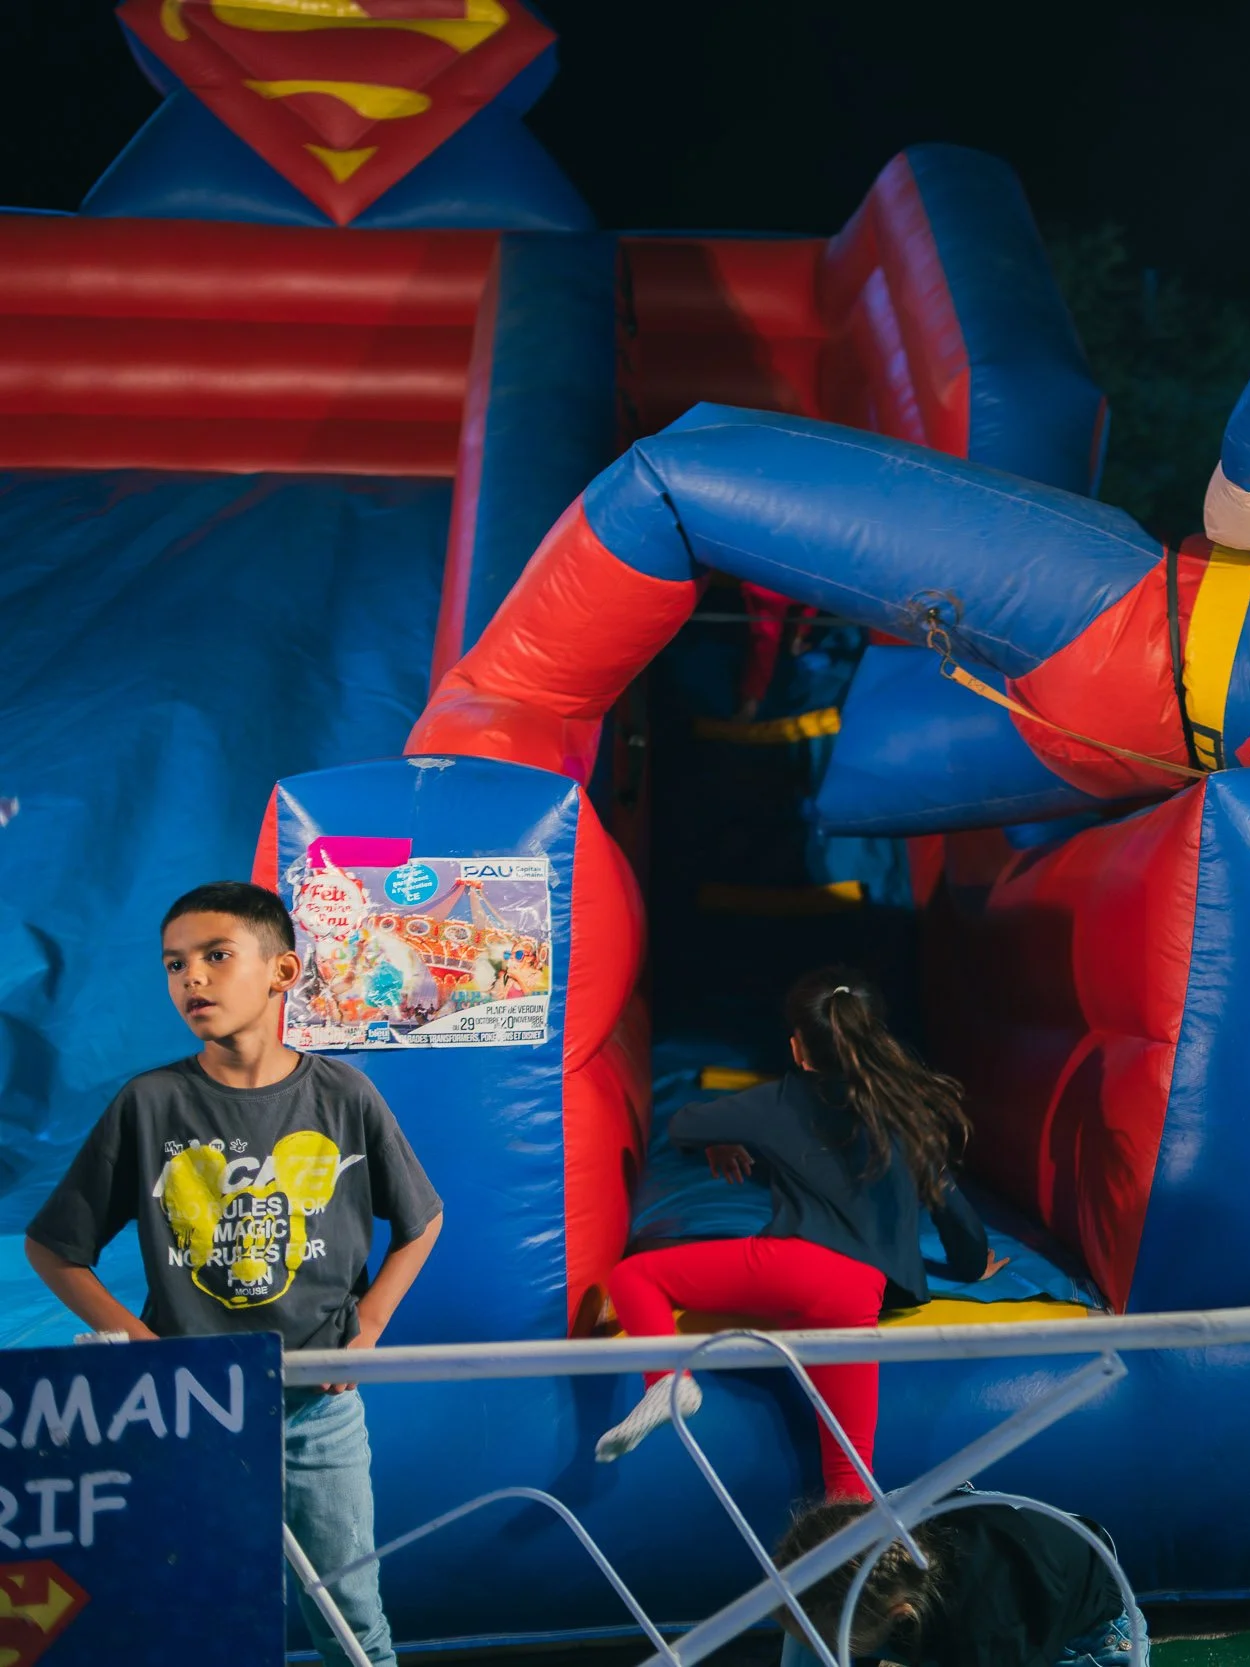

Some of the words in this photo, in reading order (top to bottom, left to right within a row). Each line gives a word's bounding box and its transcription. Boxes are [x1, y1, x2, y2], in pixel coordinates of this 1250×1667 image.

[464, 865, 513, 878] PAU
[406, 892, 421, 902] CE
[517, 1004, 544, 1014] VERDUN
[460, 1017, 475, 1031] 29
[207, 1197, 283, 1222] RULES
[213, 1218, 288, 1242] MAGIC
[168, 1246, 200, 1267] NO
[206, 1244, 281, 1267] RULES
[284, 1238, 328, 1261] FOR
[235, 1285, 269, 1296] MOUSE
